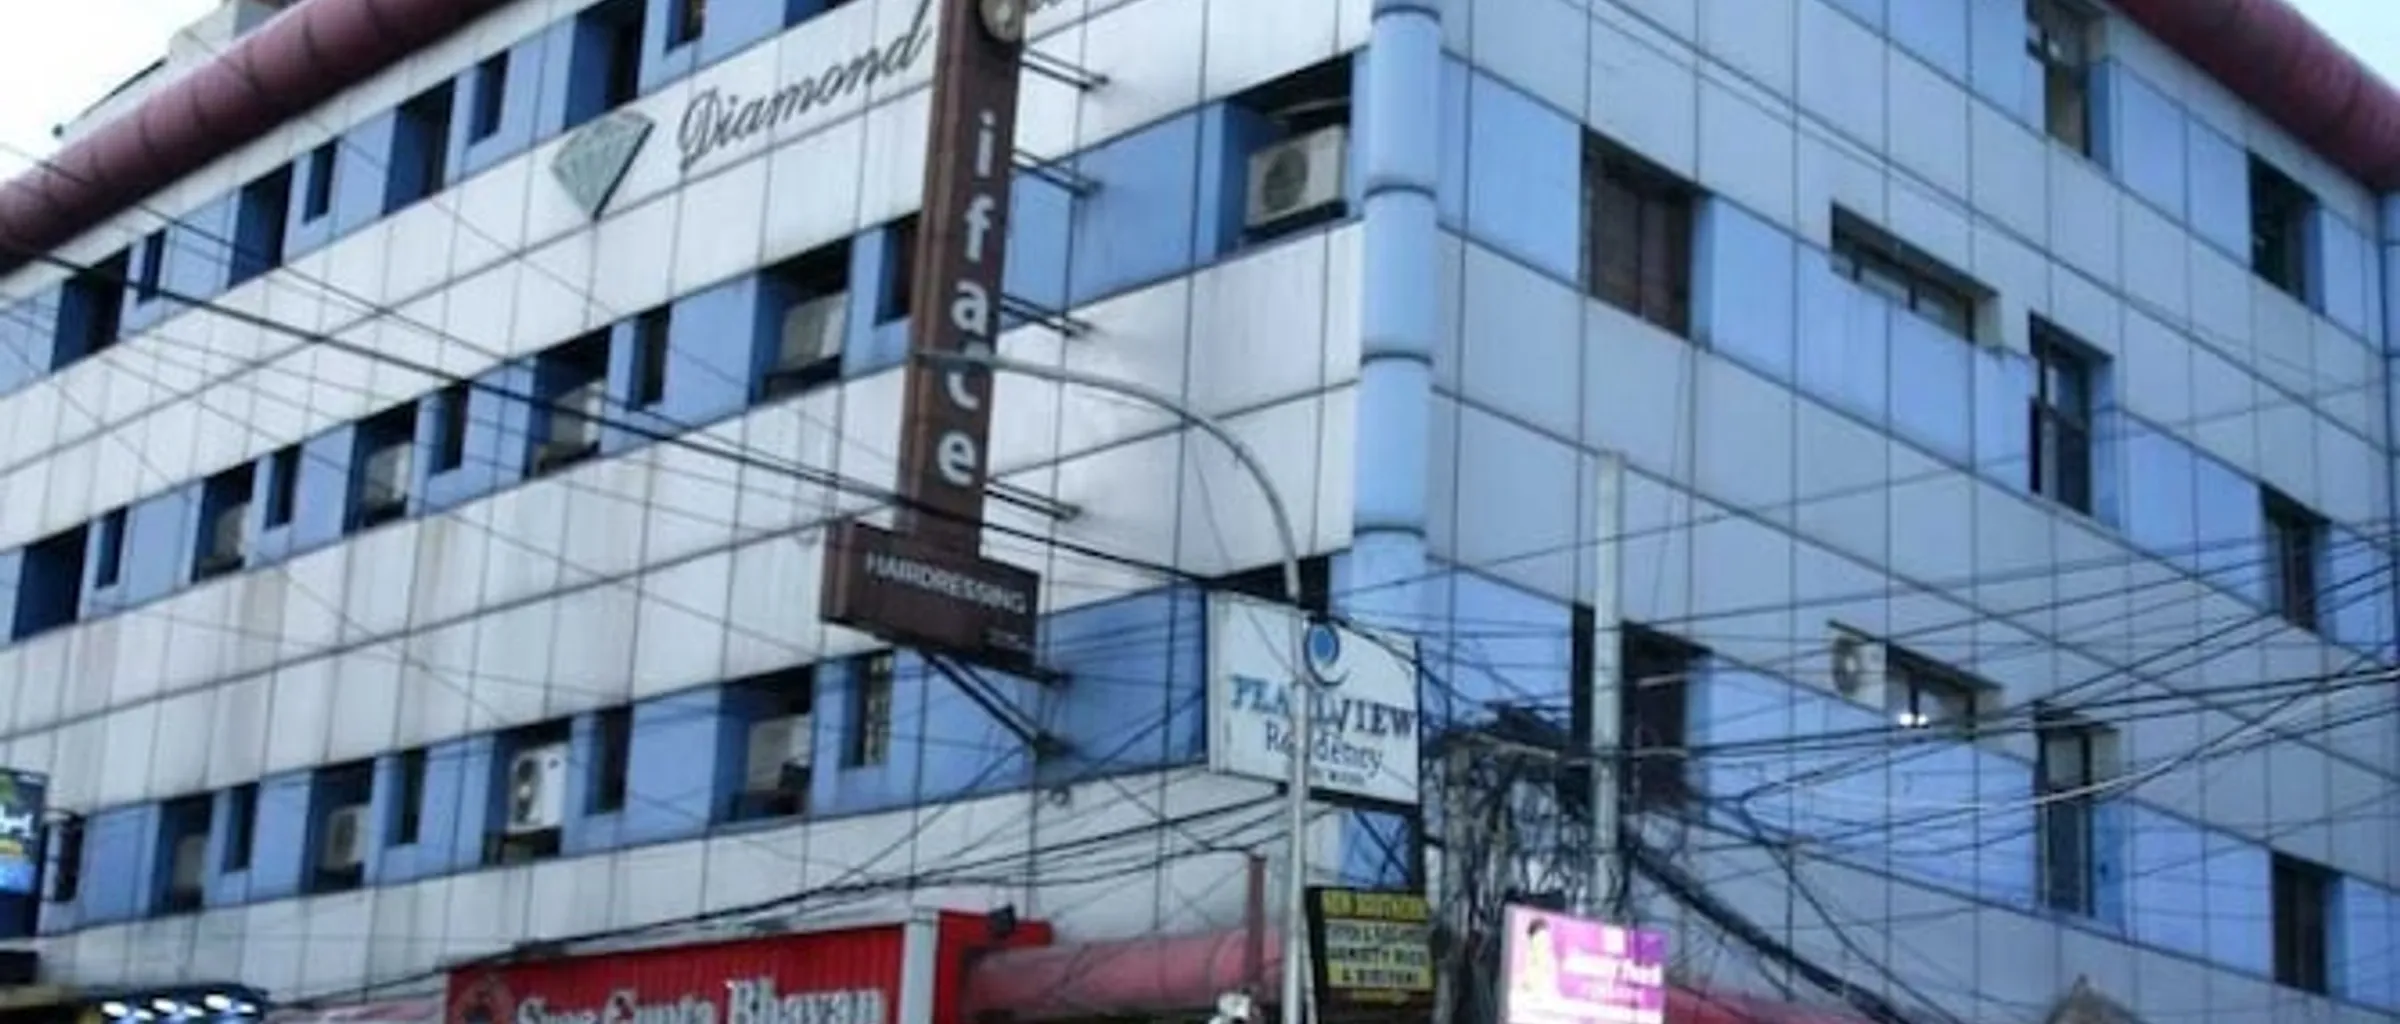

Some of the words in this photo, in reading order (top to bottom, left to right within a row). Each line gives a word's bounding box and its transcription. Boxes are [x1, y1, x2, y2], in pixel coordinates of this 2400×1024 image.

[677, 0, 933, 172] Diamond
[865, 551, 1027, 615] HAIRDRESSING
[1229, 674, 1416, 739] PEALVIEW
[726, 977, 885, 1024] Bhavan
